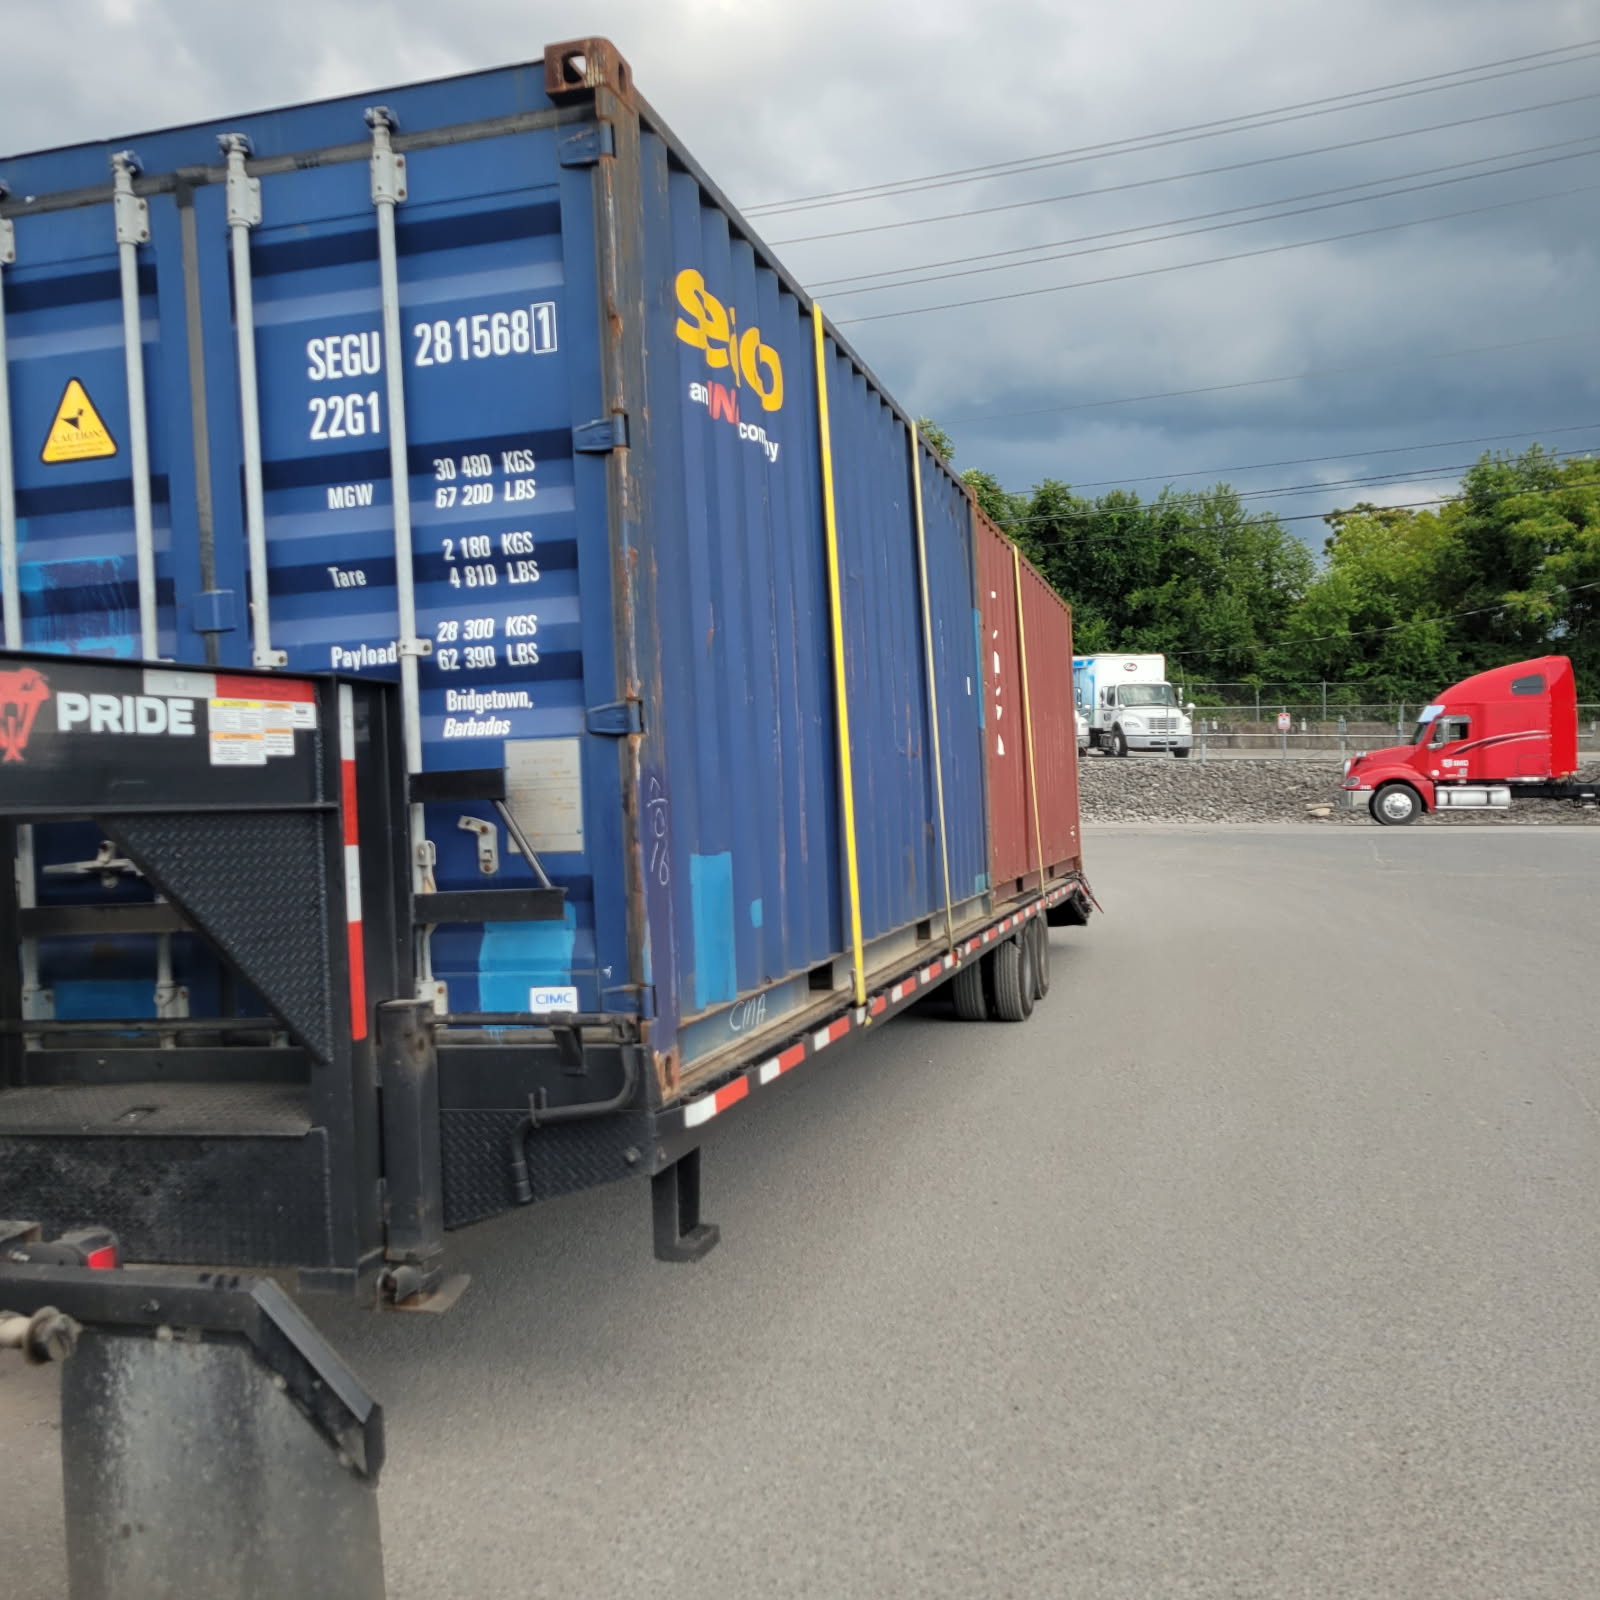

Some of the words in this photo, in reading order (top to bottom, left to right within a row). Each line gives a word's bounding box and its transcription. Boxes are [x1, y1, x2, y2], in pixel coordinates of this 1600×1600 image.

[306, 331, 381, 381] SEGU
[308, 390, 381, 440] 22G1
[433, 458, 457, 481] 30
[461, 453, 492, 478] 480
[502, 449, 536, 474] KGS
[327, 483, 374, 510] MGW
[435, 486, 457, 508] 67
[461, 483, 494, 506] 200
[504, 478, 537, 502] LBS
[442, 538, 456, 561] 2
[460, 535, 491, 559] 180
[501, 531, 535, 555] KGS
[327, 566, 367, 588] Tare
[449, 567, 461, 588] 4
[464, 564, 497, 587] 810
[507, 560, 541, 583] LBS
[436, 620, 459, 642] 28
[462, 617, 496, 641] 300
[505, 614, 538, 637] KGS
[330, 641, 397, 671] Payload
[437, 647, 461, 670] 62
[465, 645, 497, 668] 390
[506, 642, 540, 666] LBS
[57, 691, 196, 736] PRIDE
[446, 688, 534, 715] Bridgetown,
[443, 716, 512, 738] Barbados
[535, 991, 574, 1005] CIMC
